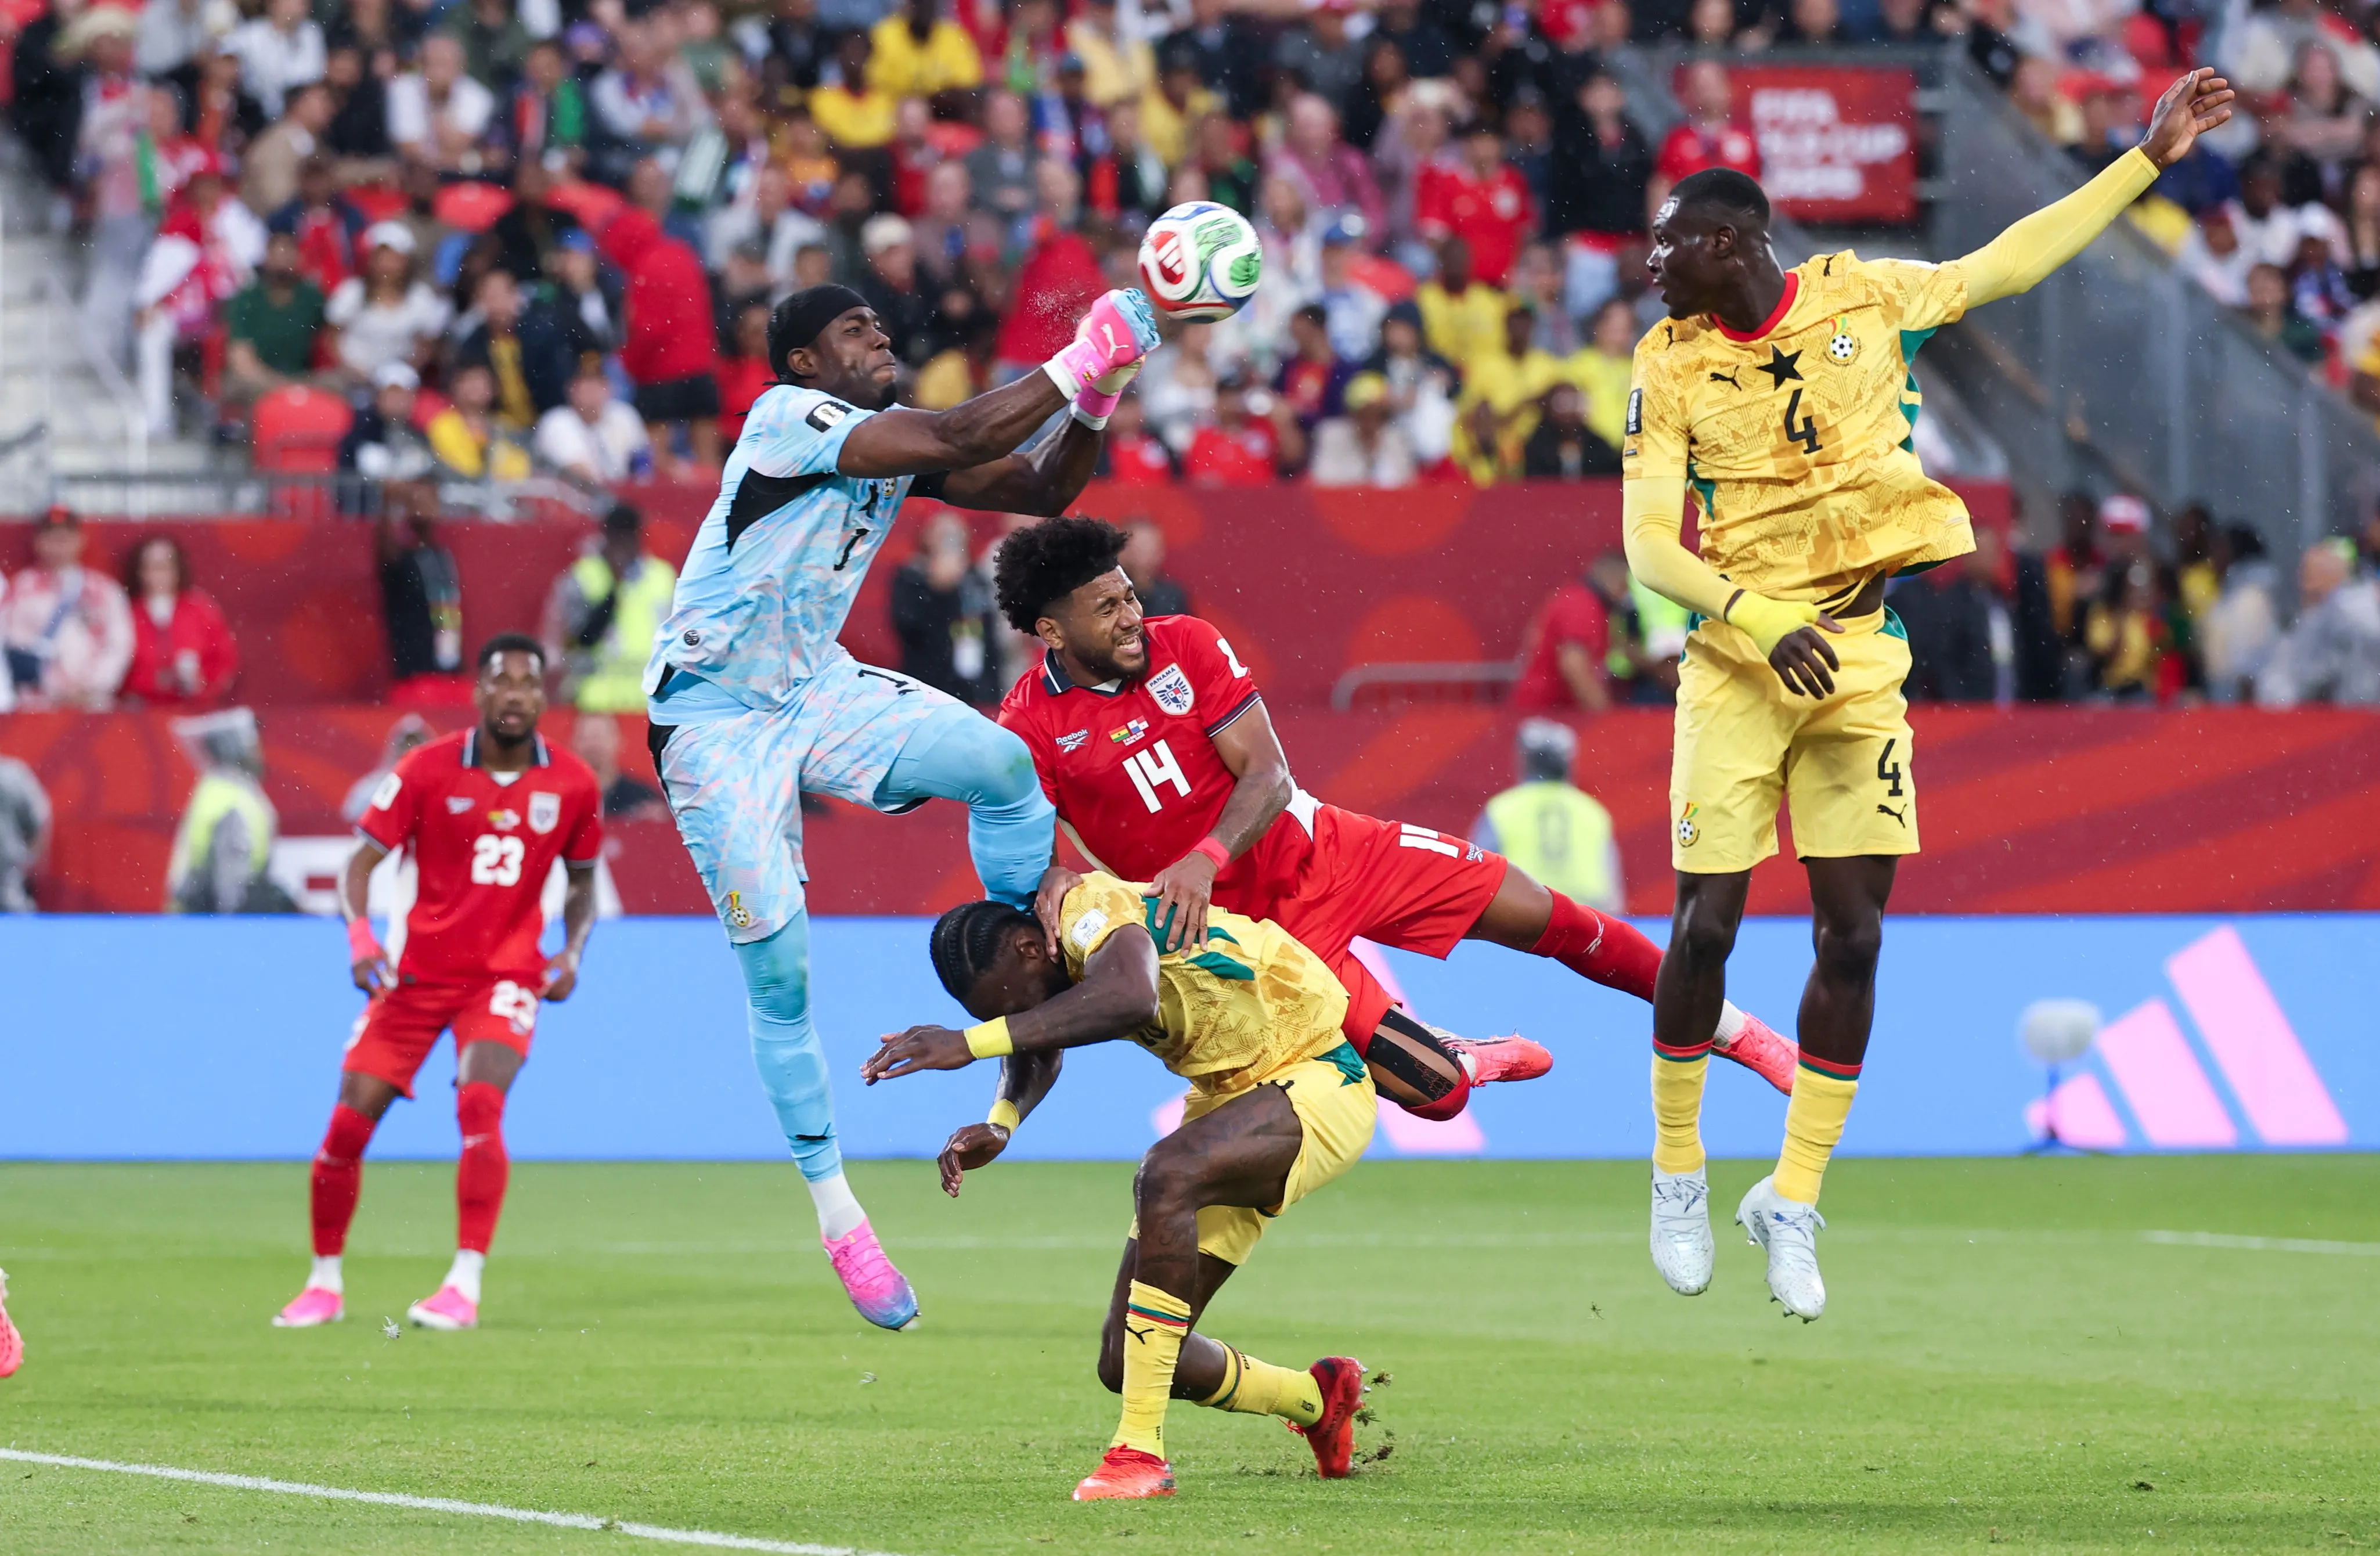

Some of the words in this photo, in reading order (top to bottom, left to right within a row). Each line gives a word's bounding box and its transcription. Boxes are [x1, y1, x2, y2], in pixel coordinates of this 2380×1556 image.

[1784, 387, 1823, 454] 4
[834, 528, 870, 571] 1
[1149, 667, 1177, 687] PANAMA
[1055, 729, 1088, 745] Reebok
[1122, 739, 1192, 814] 14
[1877, 738, 1903, 797] 4
[471, 834, 525, 887] 23
[489, 979, 539, 1031] 23
